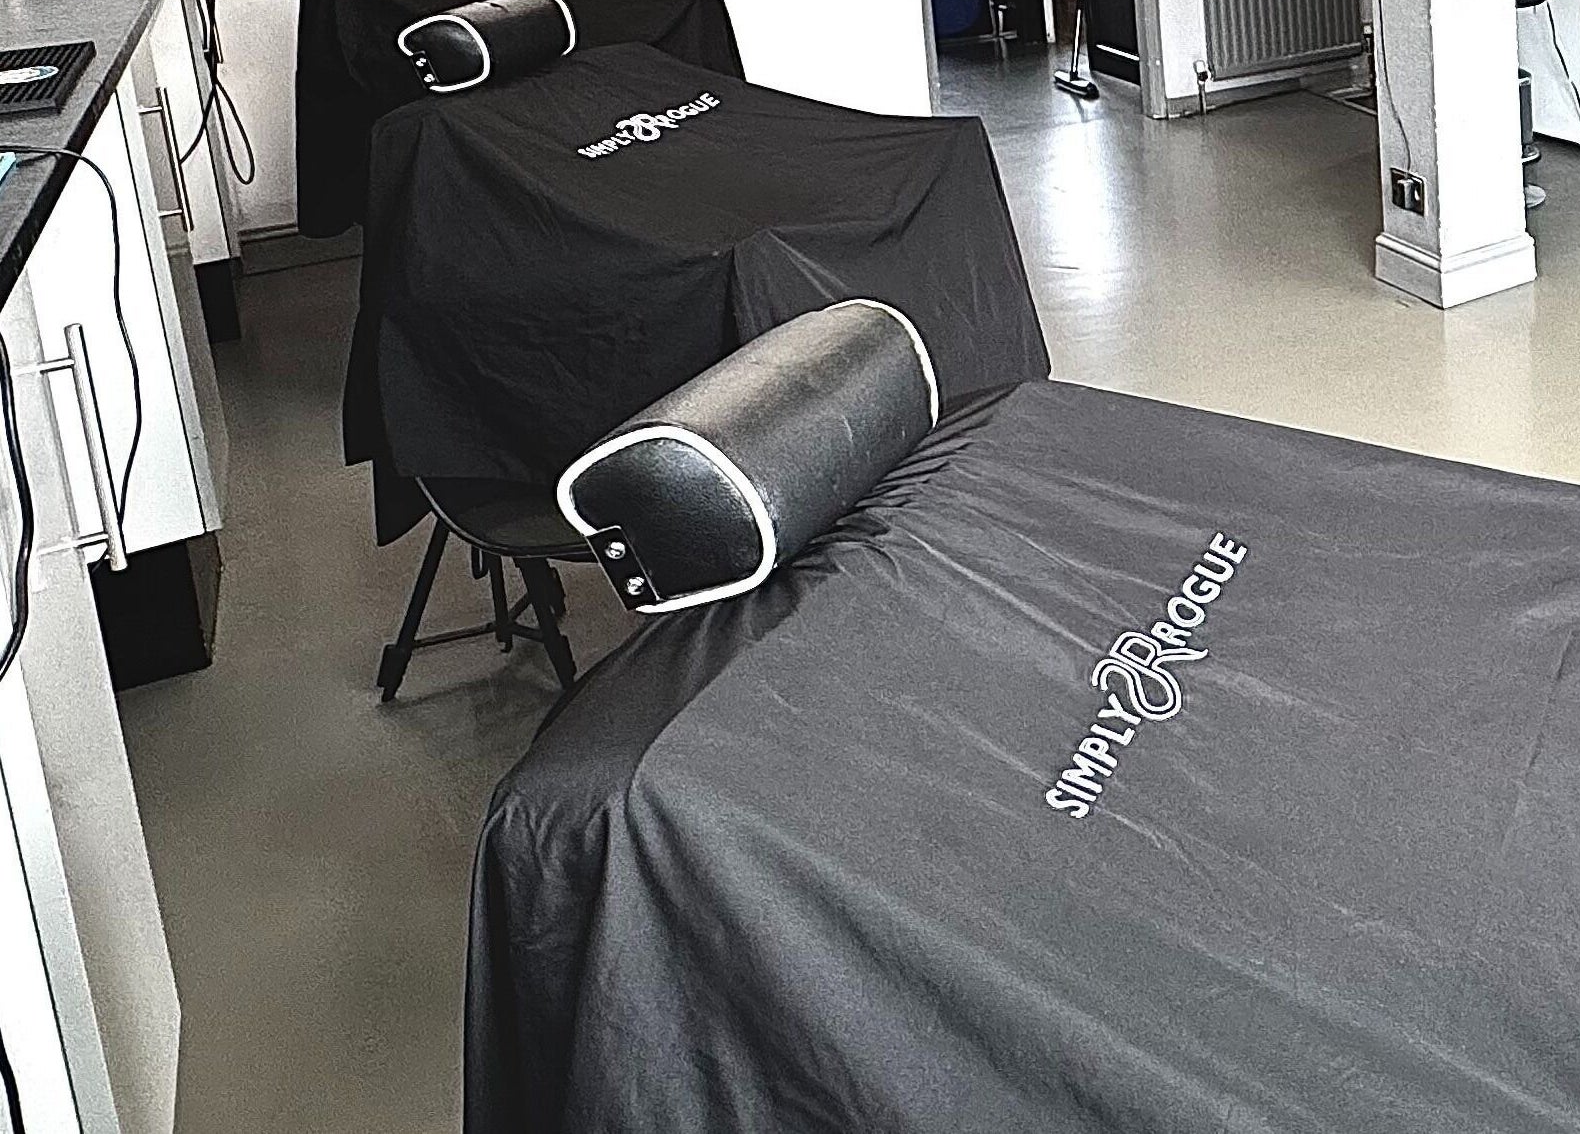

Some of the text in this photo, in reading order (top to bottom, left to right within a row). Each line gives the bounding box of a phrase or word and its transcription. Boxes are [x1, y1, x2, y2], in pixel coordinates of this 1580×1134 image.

[655, 92, 721, 125] ROGUE
[1045, 692, 1142, 819] SIMPLY
[1150, 531, 1248, 647] ROGUE
